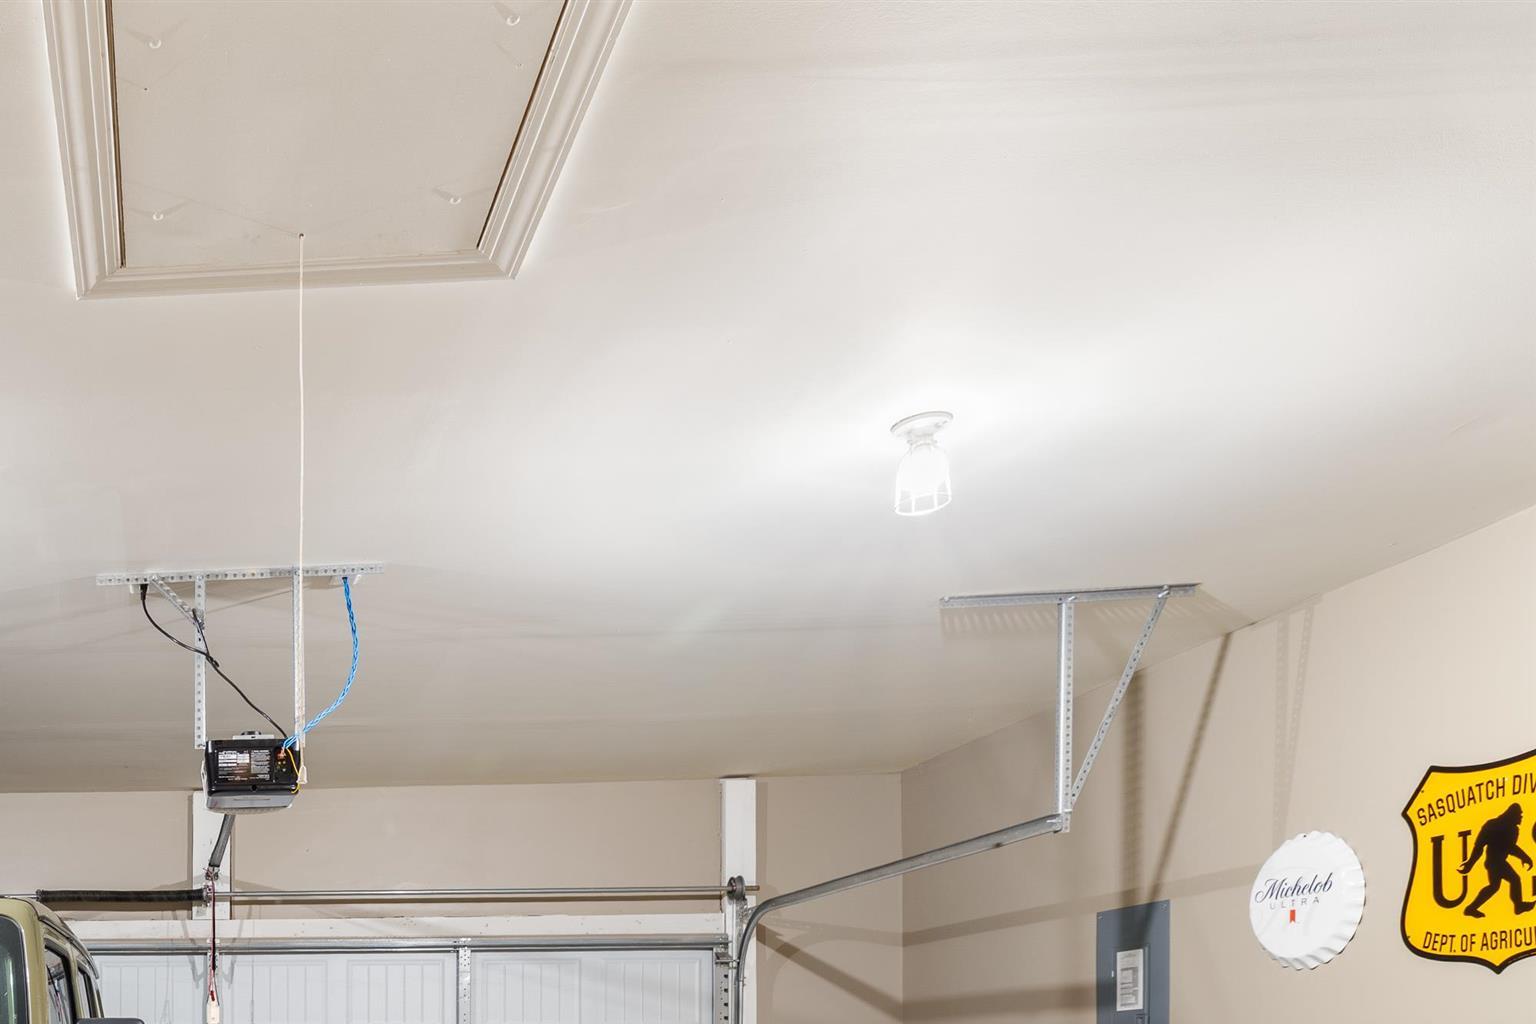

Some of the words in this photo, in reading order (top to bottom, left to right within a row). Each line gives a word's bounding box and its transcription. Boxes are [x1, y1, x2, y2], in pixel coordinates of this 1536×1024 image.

[1417, 776, 1506, 826] SASQUATCH
[1254, 872, 1333, 903] Michelob
[1269, 896, 1320, 910] ULTRA
[1423, 930, 1457, 953] DEPT.
[1461, 933, 1476, 952] OF
[1481, 926, 1536, 951] AGRICU
